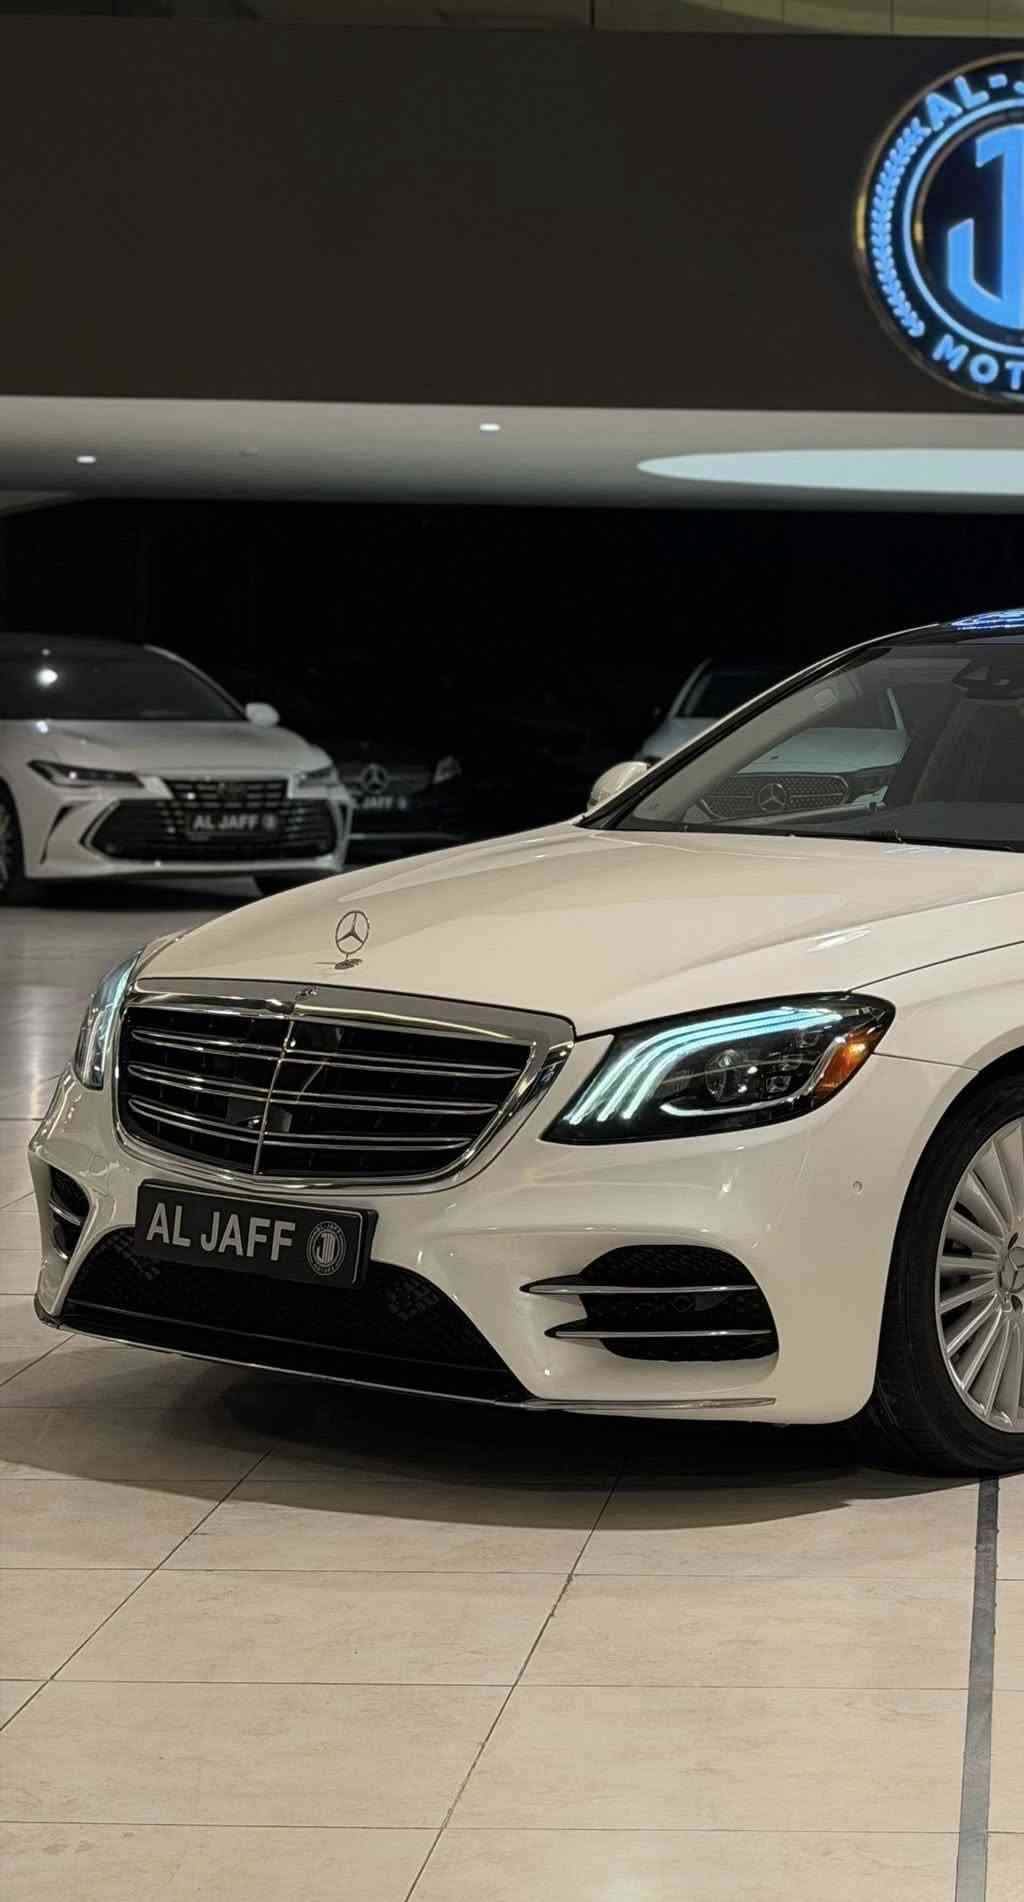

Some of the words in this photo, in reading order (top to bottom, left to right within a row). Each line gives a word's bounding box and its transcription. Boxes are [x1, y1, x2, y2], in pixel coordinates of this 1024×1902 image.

[193, 814, 216, 830] AL
[217, 813, 259, 831] JAFF
[146, 1202, 191, 1247] AL
[201, 1211, 296, 1262] JAFF
